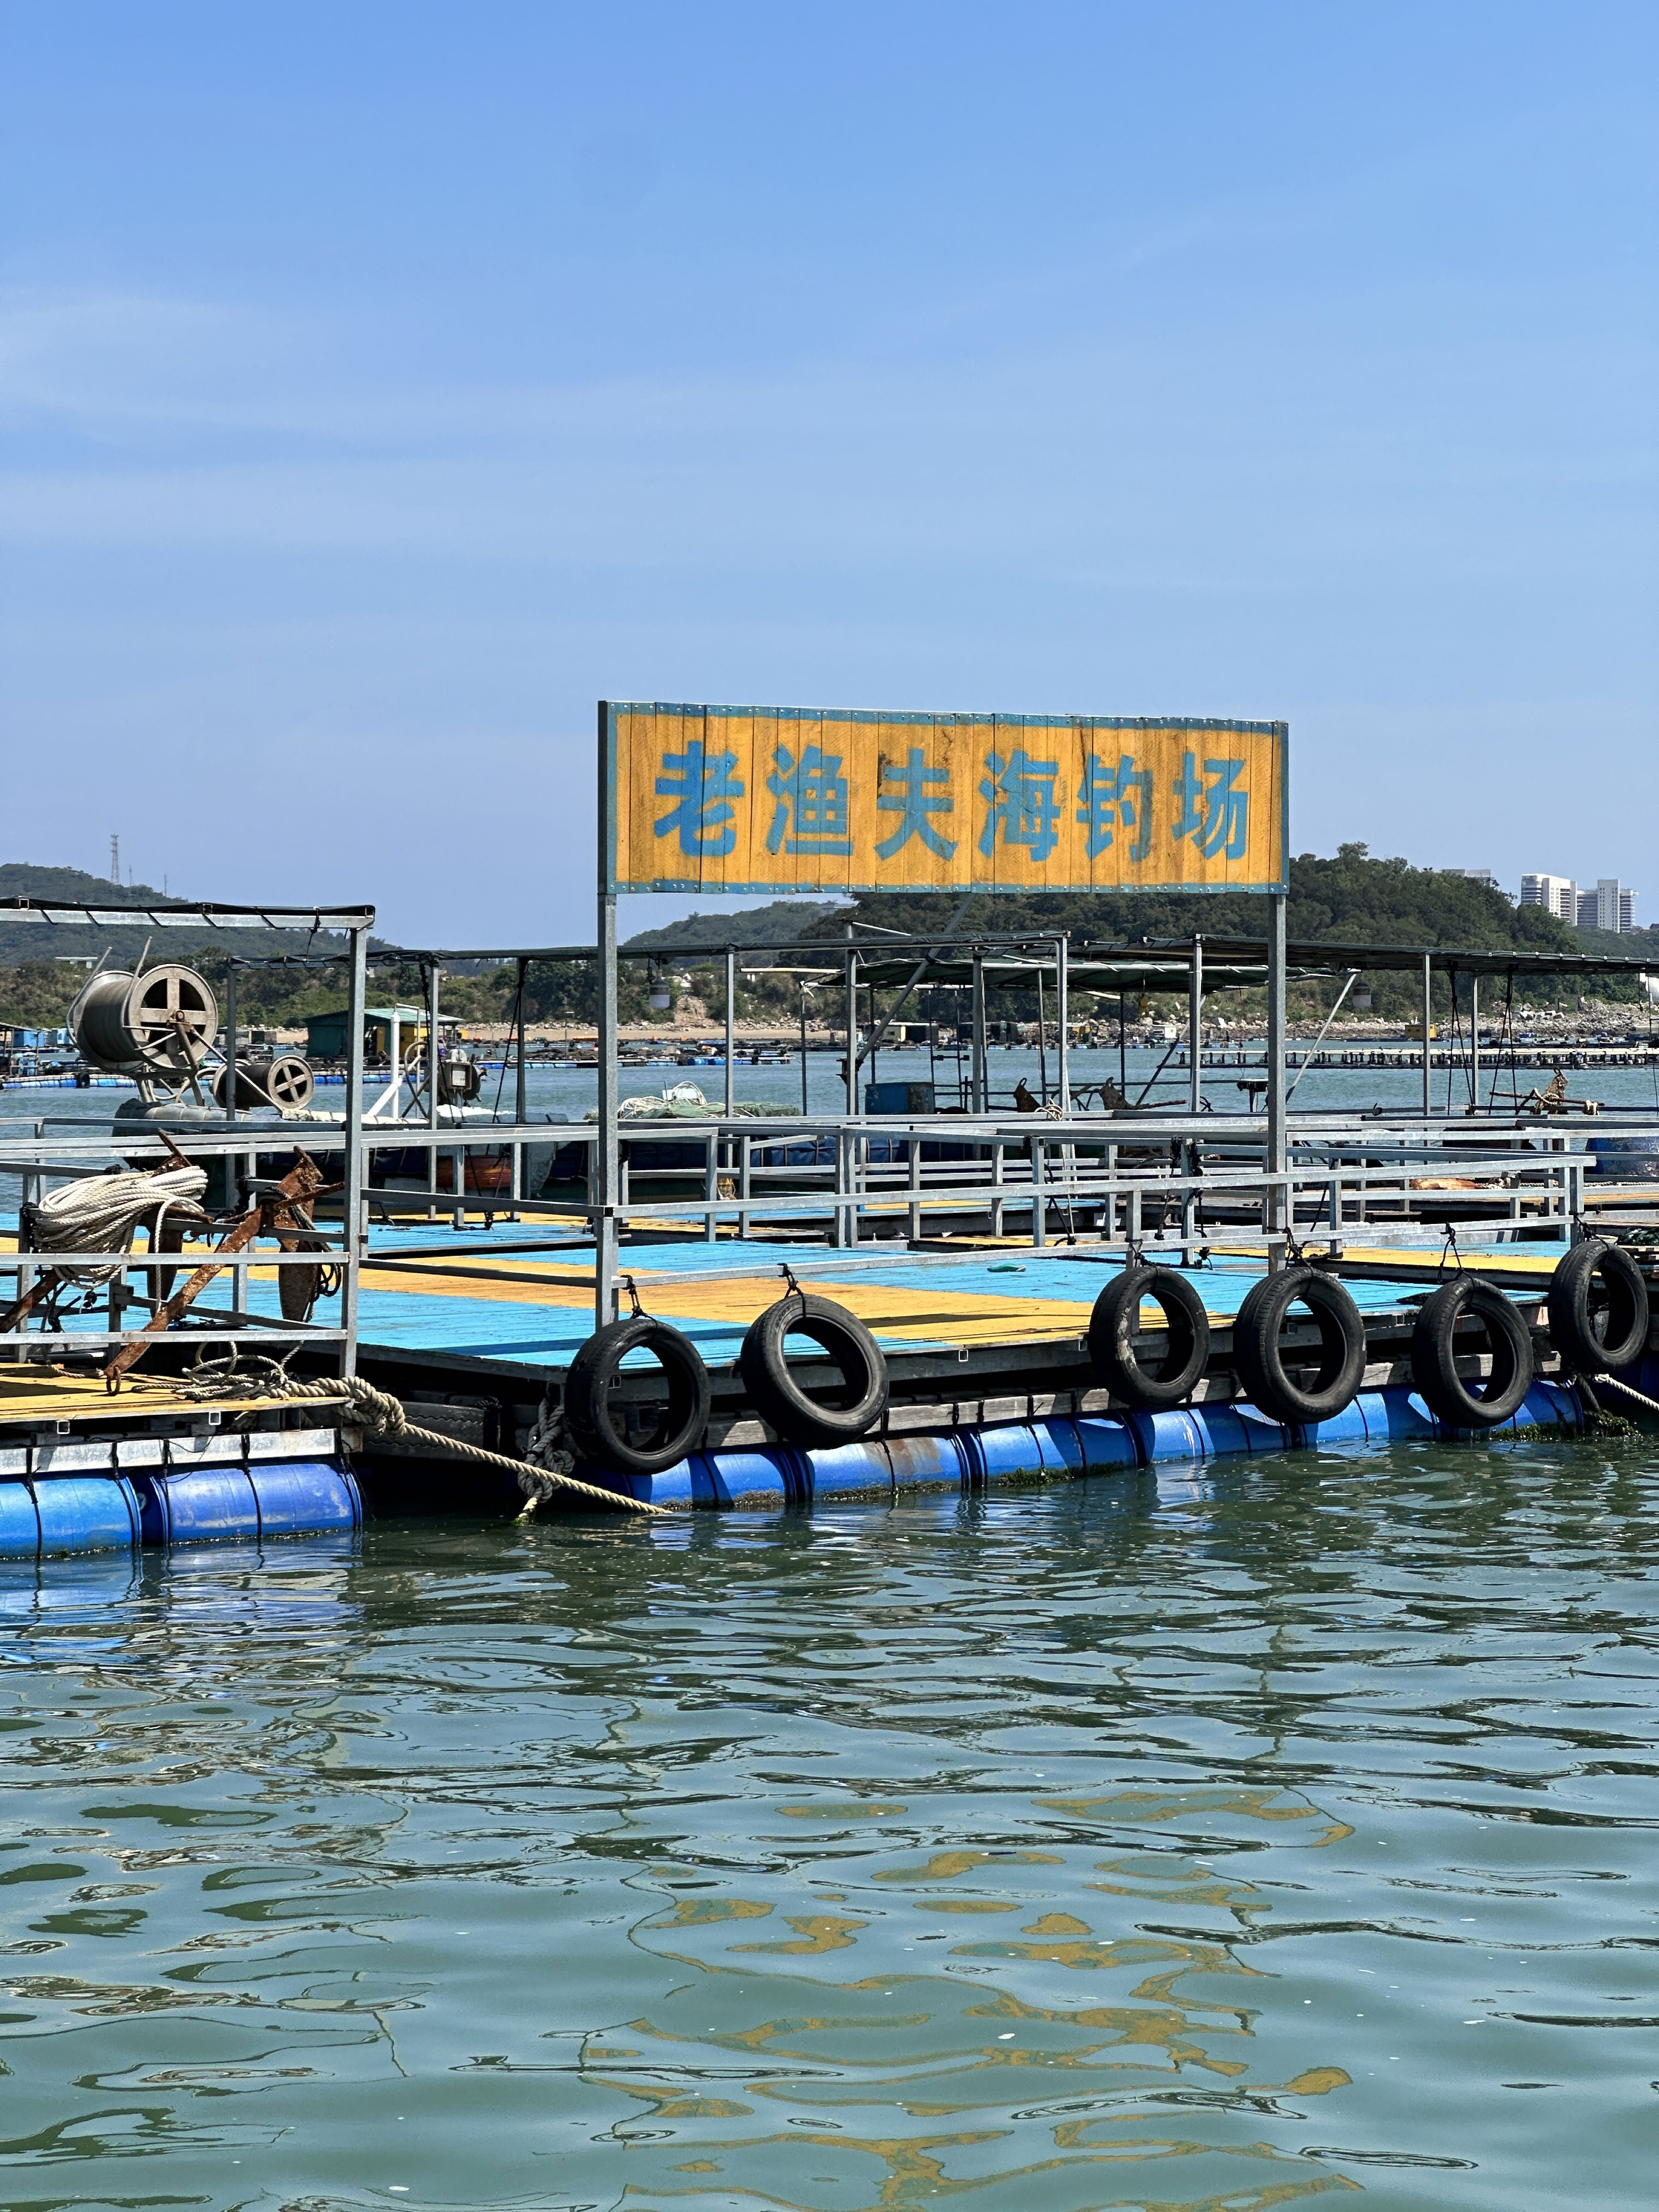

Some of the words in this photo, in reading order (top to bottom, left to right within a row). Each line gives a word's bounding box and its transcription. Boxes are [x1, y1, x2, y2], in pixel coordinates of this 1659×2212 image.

[653, 741, 1249, 862] 老渔夫海钓场
